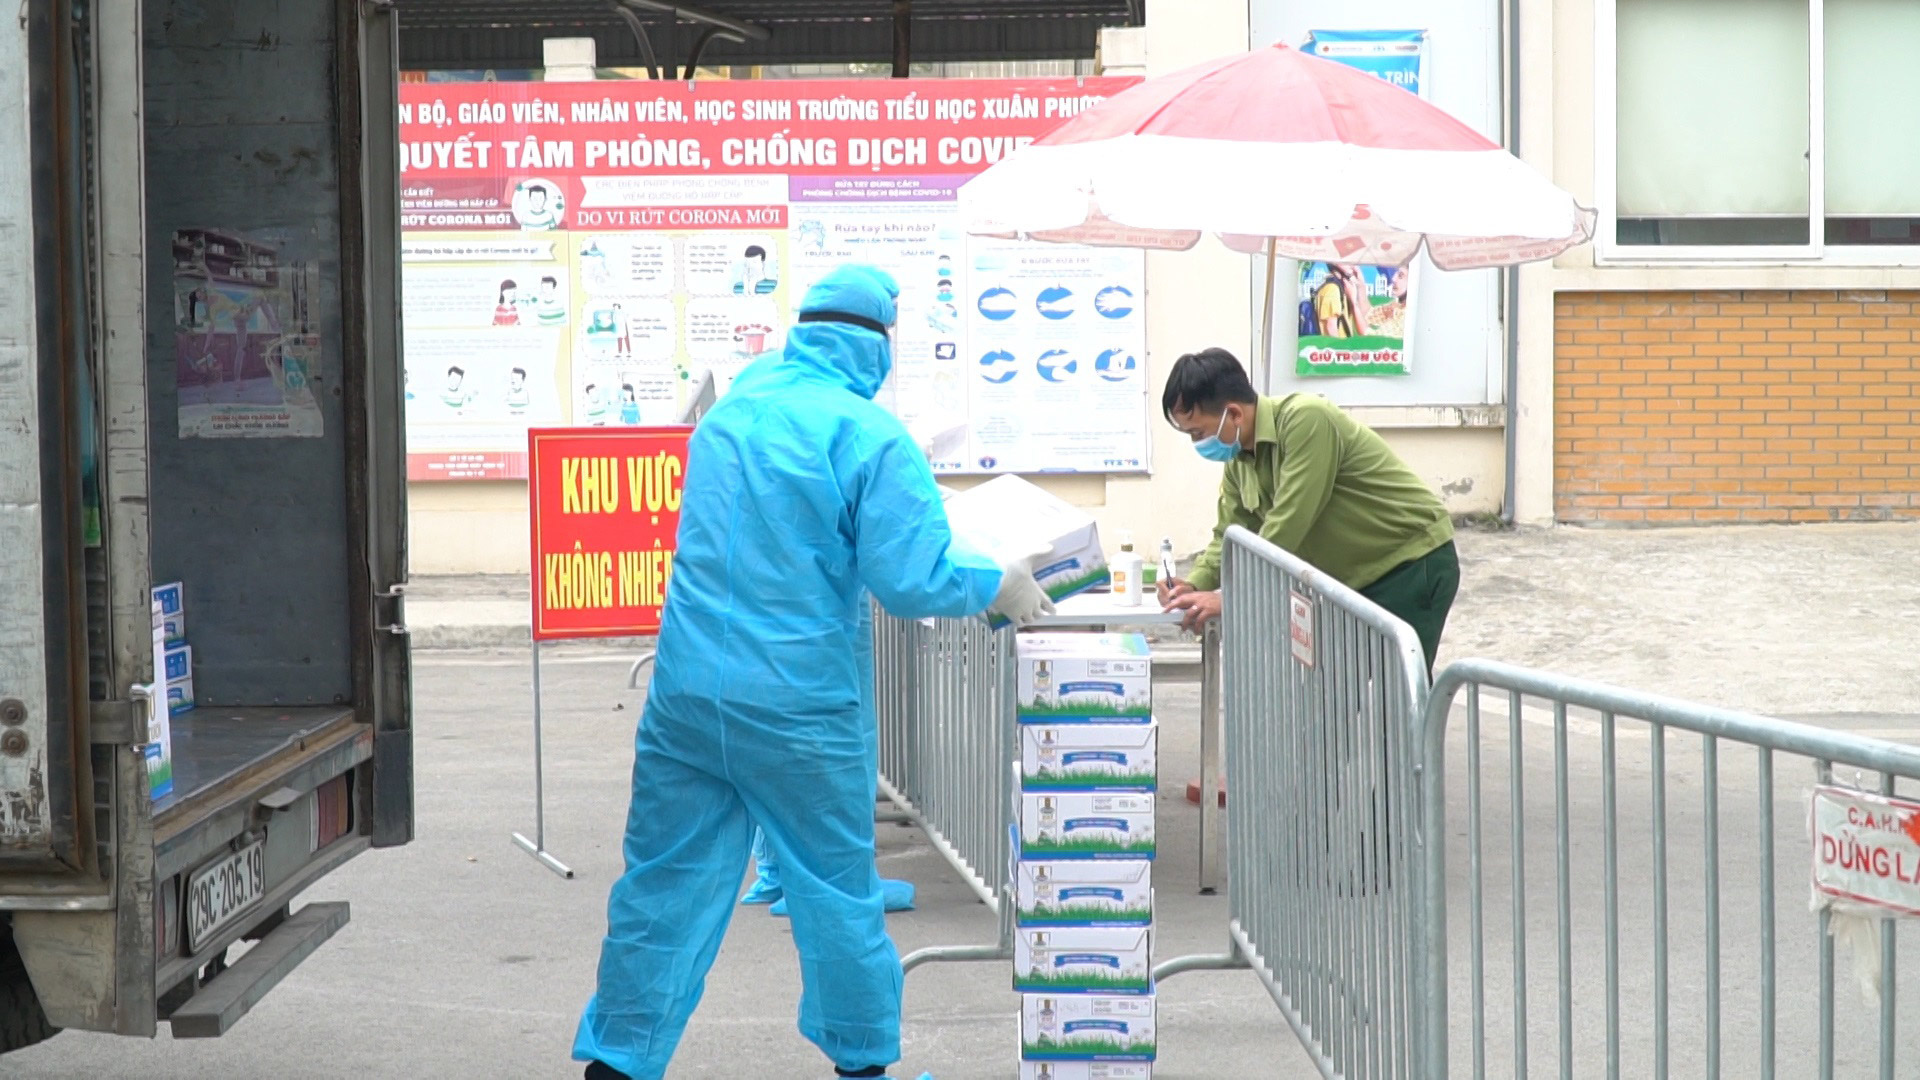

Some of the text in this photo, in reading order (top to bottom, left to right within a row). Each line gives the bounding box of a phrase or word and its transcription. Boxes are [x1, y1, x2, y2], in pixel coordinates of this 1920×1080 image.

[398, 103, 412, 124] N
[418, 98, 452, 128] BỘ,
[458, 98, 505, 124] GIÁO
[511, 98, 564, 125] VIÊN,
[571, 97, 629, 123] NHÂN
[635, 97, 688, 125] VIÊN,
[694, 100, 735, 126] HỌC
[742, 100, 791, 122] SINH
[797, 94, 878, 121] TRƯỜNG
[884, 90, 929, 121] TIỂU
[935, 99, 976, 124] HỌC
[982, 93, 1039, 120] XUÂN
[502, 135, 574, 168] TÂM
[585, 132, 711, 170] PHÒNG,
[721, 128, 837, 166] CHỐNG
[848, 137, 927, 171] DỊCH
[937, 136, 1034, 166] COVI
[428, 214, 483, 226] CORONA
[484, 212, 511, 225] MỚI
[577, 211, 603, 226] DO
[605, 210, 625, 226] VI
[628, 206, 666, 226] RÚT
[669, 209, 743, 225] CORONA
[746, 205, 780, 225] MỚI
[561, 450, 682, 525] KHU VỰC
[545, 540, 613, 610] KHÔNG
[1848, 806, 1908, 835] C.A.H.
[1822, 829, 1891, 878] DỪNG
